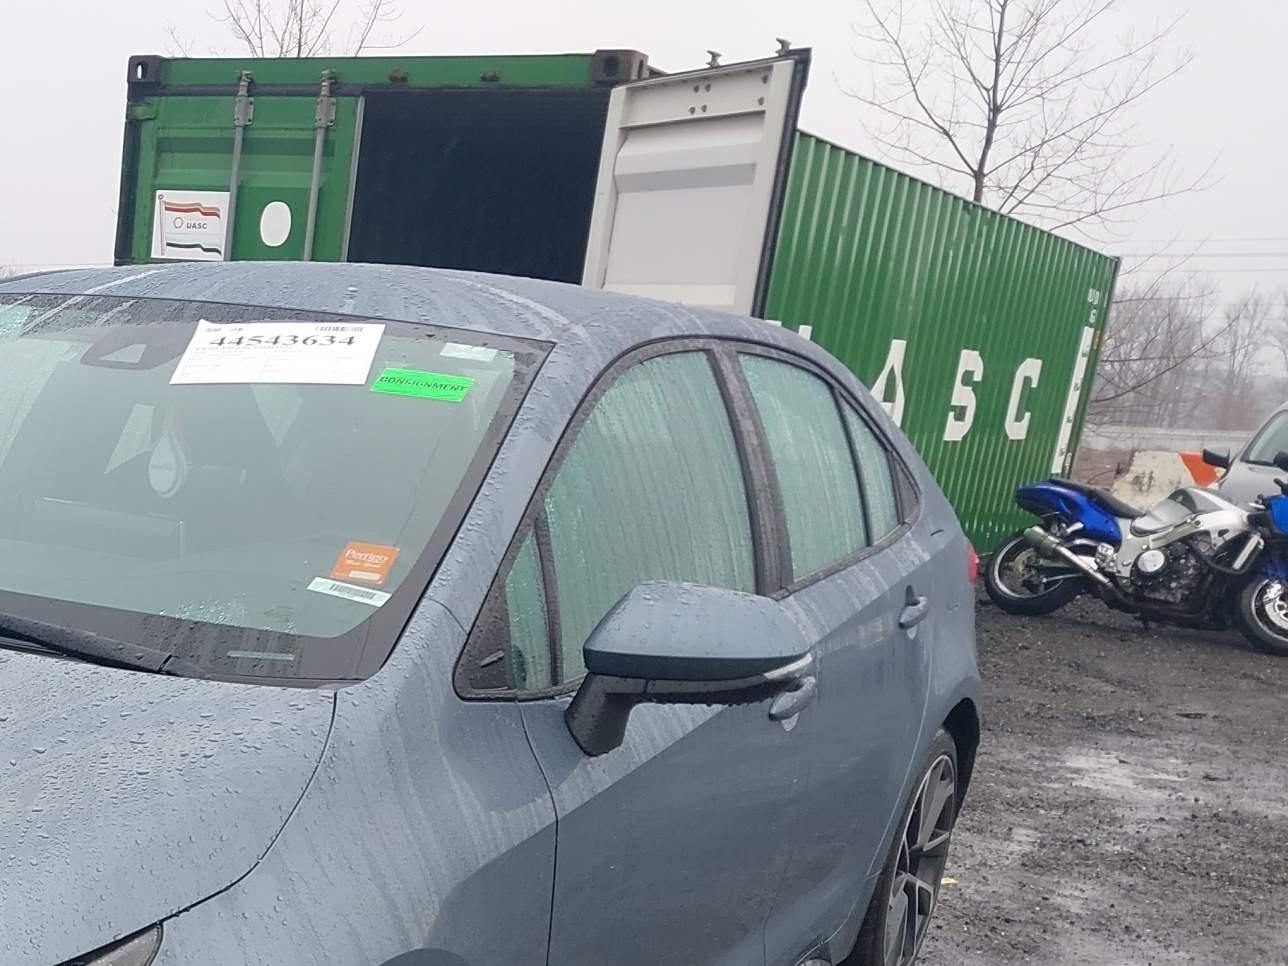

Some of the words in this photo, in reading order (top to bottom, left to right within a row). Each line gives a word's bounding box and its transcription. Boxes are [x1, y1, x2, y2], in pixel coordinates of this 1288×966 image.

[186, 222, 208, 230] UASC
[210, 335, 357, 347] 44543634
[379, 376, 468, 392] CONSIGNMENT
